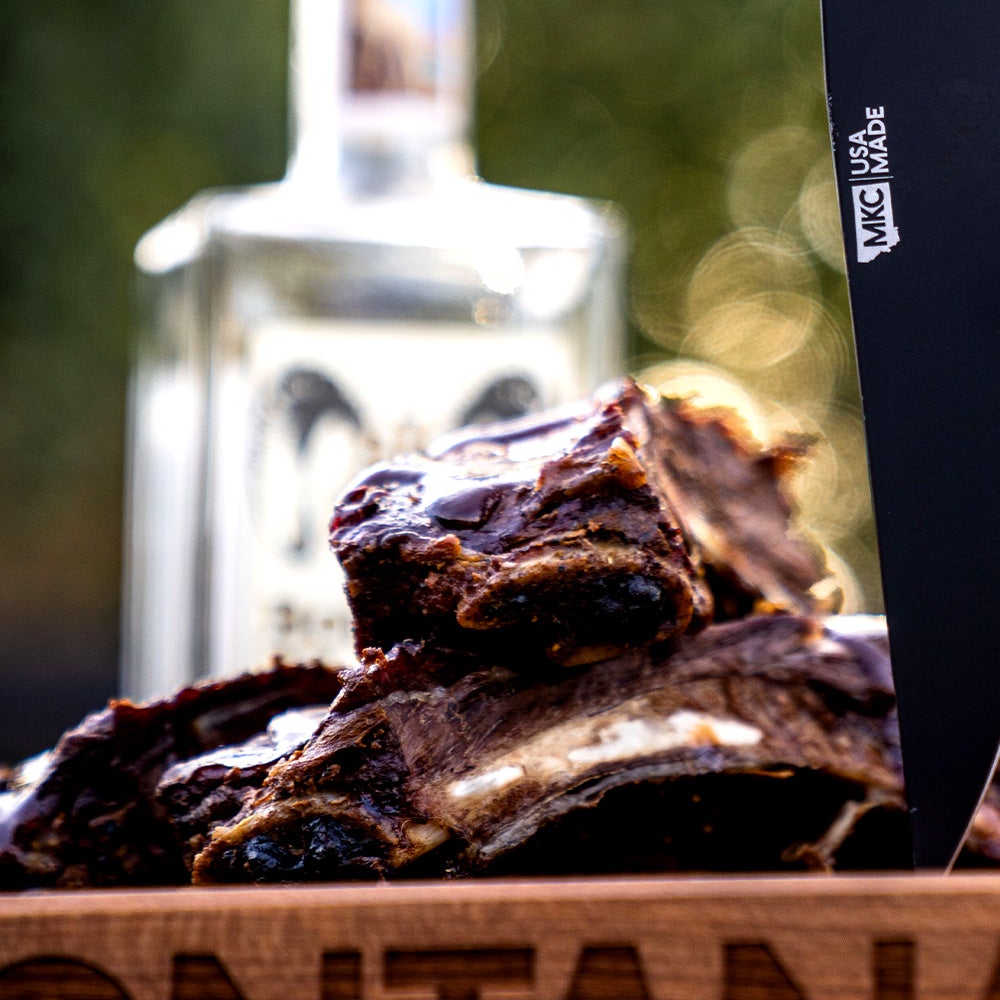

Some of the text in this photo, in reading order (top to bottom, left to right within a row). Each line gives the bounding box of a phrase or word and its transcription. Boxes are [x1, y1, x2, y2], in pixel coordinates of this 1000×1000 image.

[849, 129, 870, 175] USA
[865, 106, 889, 174] MADE
[859, 188, 888, 247] MKC
